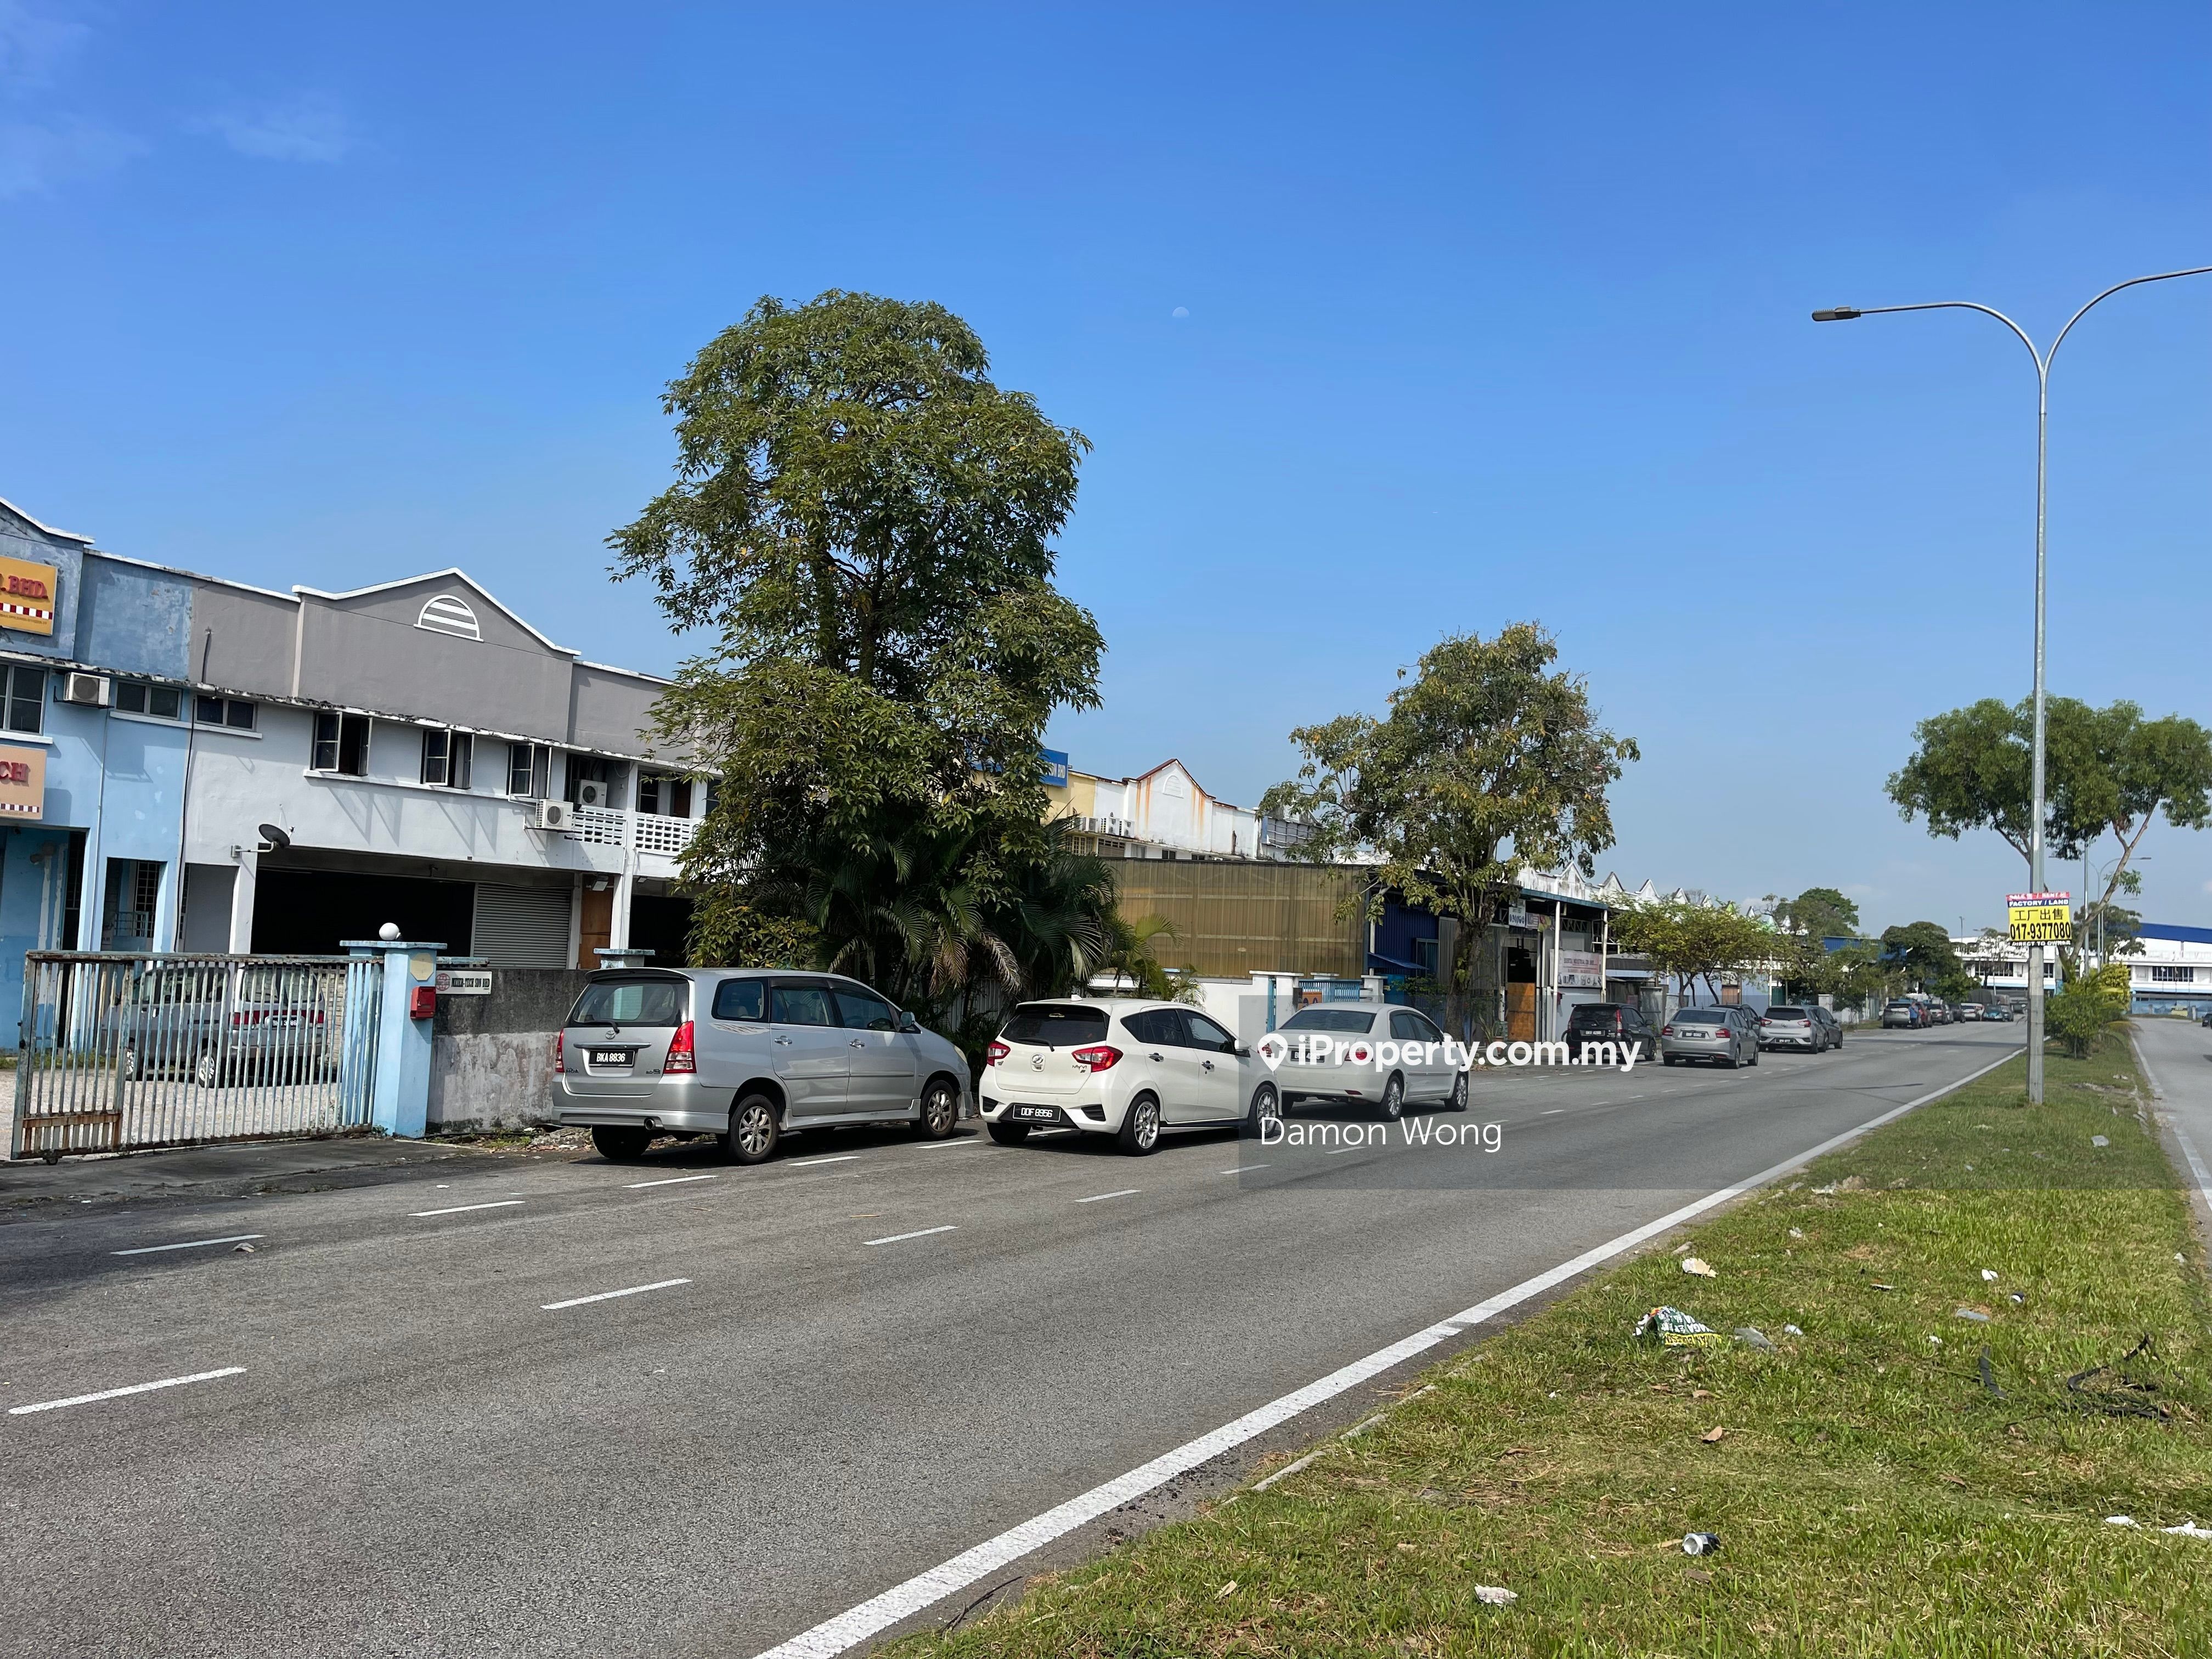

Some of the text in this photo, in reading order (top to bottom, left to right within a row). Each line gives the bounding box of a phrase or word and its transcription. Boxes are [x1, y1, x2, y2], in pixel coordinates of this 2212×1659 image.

[2015, 908, 2063, 921] 工厂出售
[2010, 922, 2071, 940] 017-9377080
[596, 1053, 625, 1062] BKA 8836
